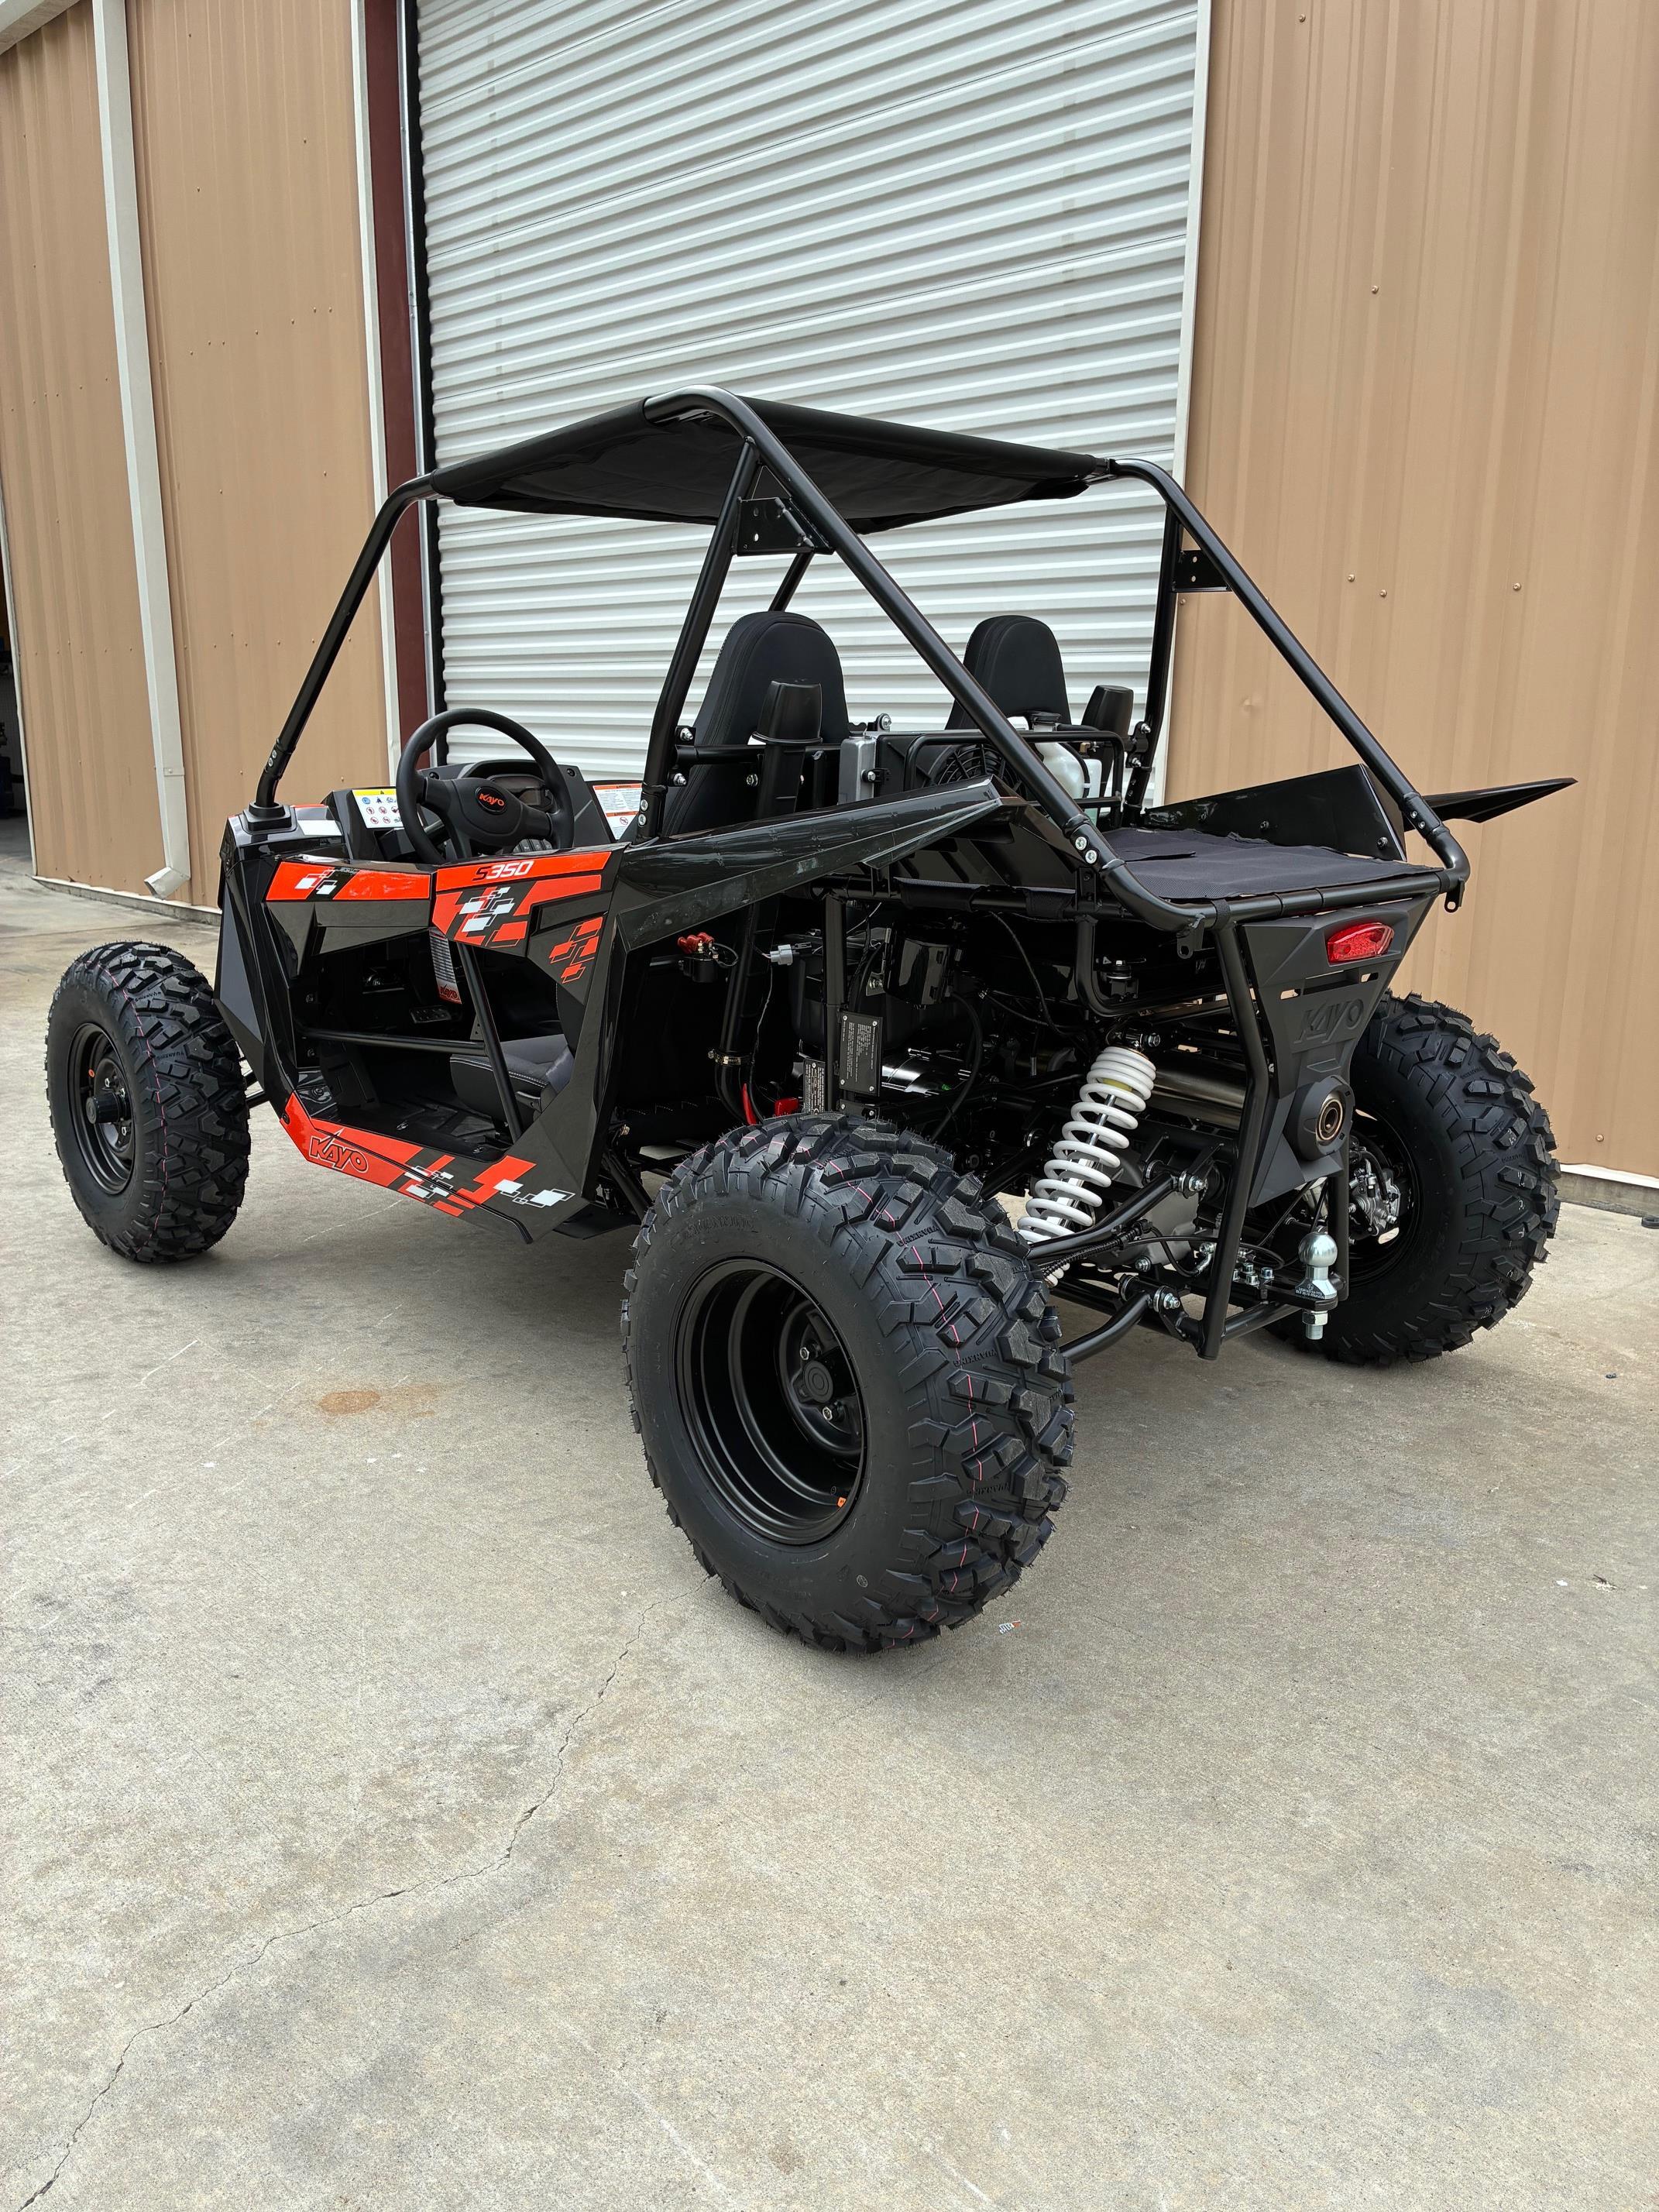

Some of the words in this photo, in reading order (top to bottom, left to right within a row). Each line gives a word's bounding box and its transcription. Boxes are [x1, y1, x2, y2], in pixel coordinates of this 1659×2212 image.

[479, 793, 505, 806] KAYO
[472, 860, 534, 881] S350
[1293, 998, 1364, 1044] KAYO
[309, 1128, 369, 1173] KAYO
